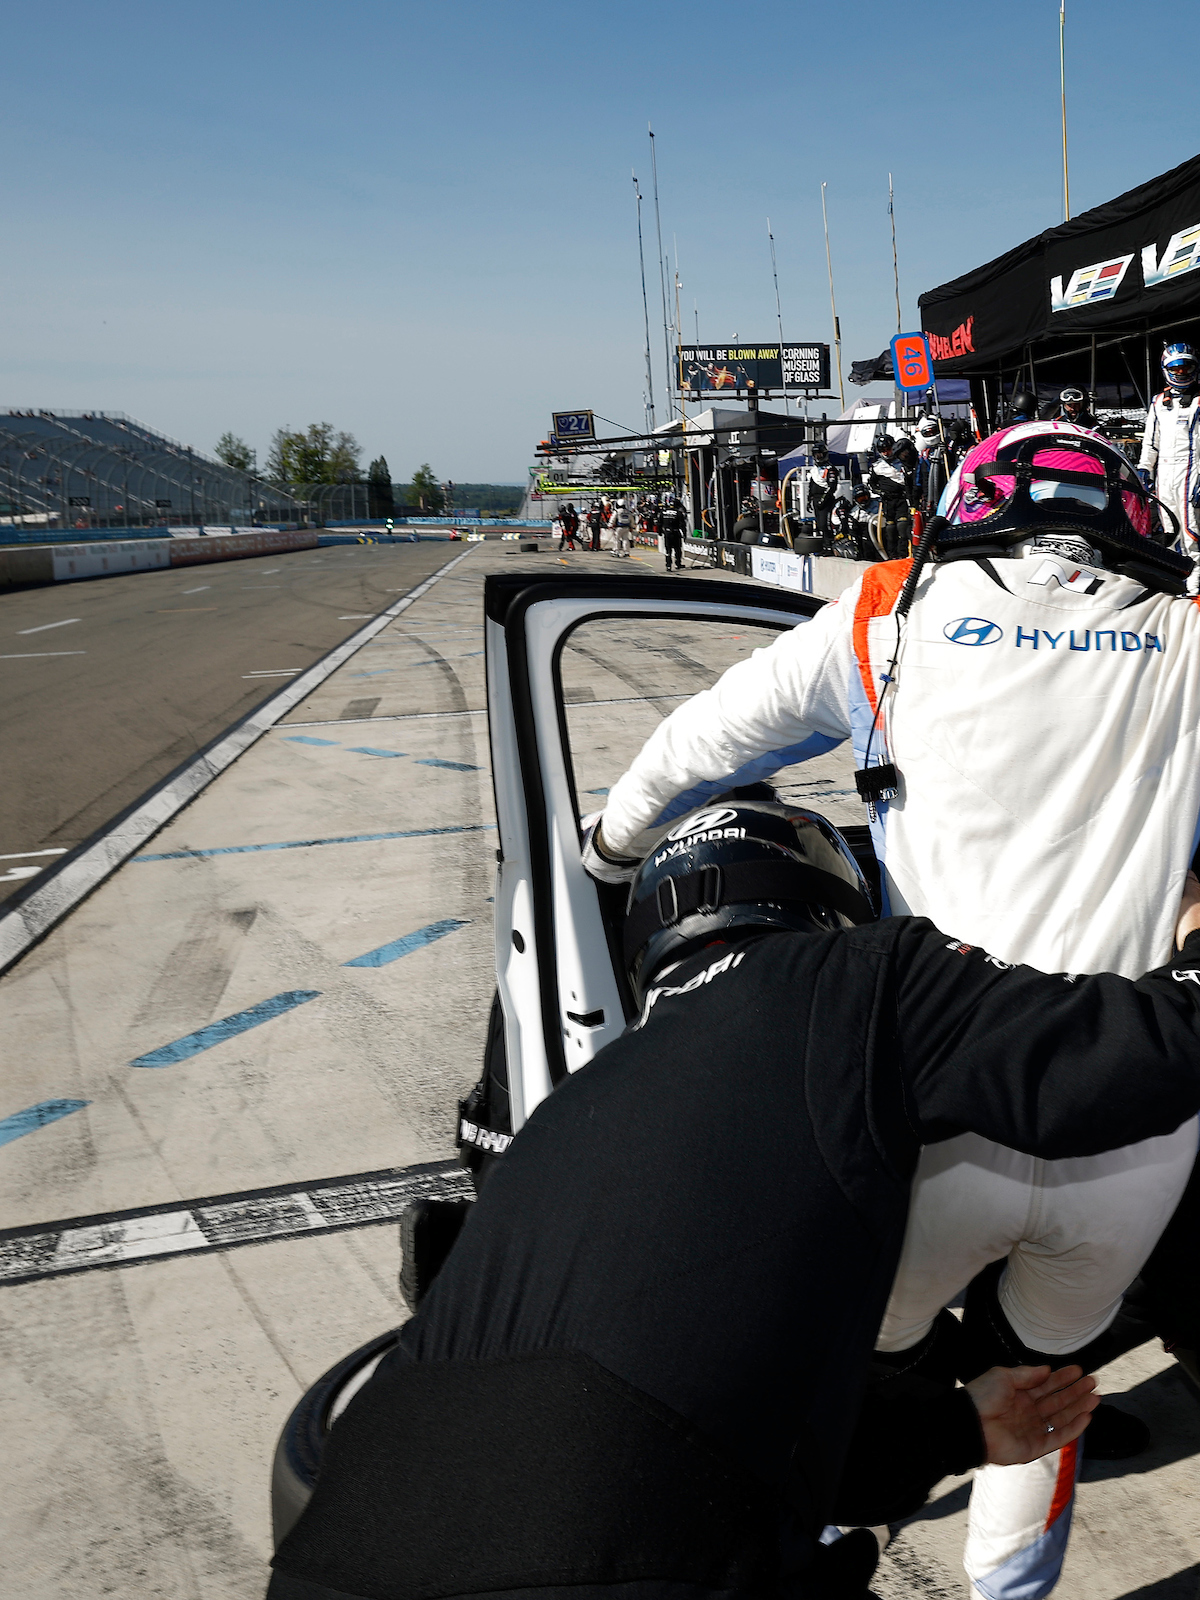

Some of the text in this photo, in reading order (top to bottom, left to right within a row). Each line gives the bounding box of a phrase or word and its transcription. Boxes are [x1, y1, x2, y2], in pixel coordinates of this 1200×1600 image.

[925, 315, 976, 361] WHELEN
[679, 348, 780, 362] YOU WILL BE BLOWN AWAY
[783, 348, 820, 360] CORNING
[784, 360, 820, 372] MUSEUM
[902, 347, 923, 376] 46
[784, 371, 821, 383] OF GLASS
[569, 415, 588, 430] 27
[553, 472, 565, 483] 01
[1015, 625, 1166, 654] HYUNDAI
[654, 827, 747, 868] HYUNDAI
